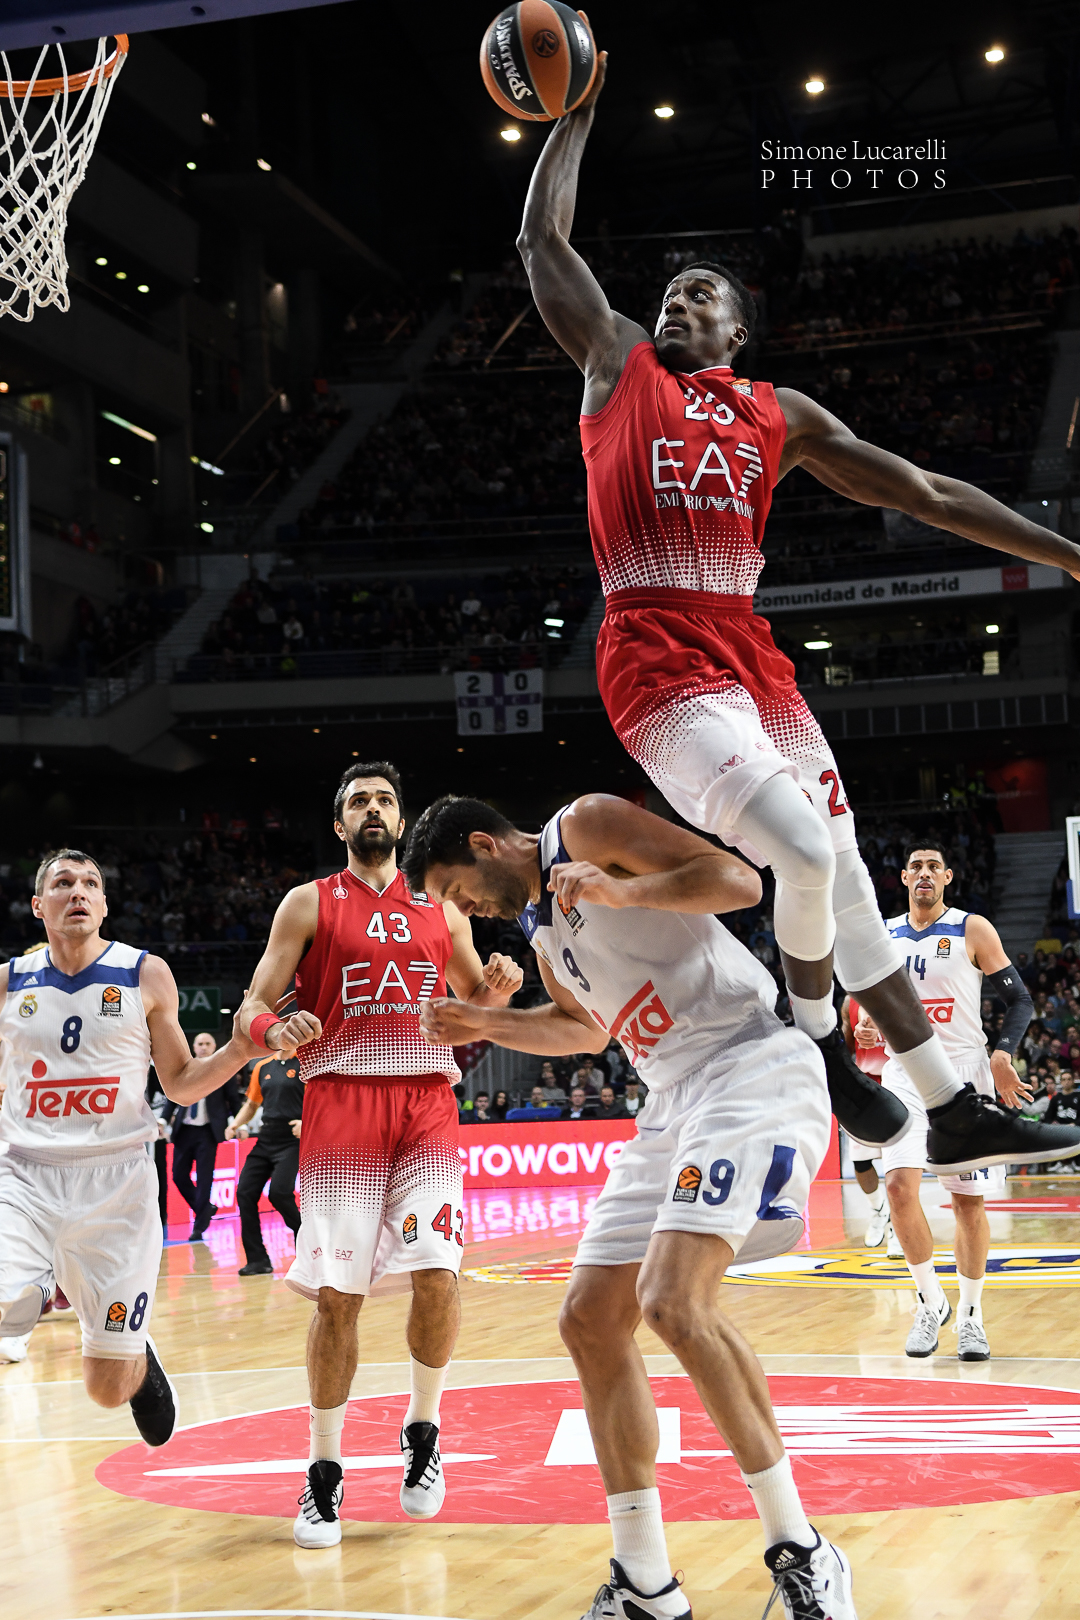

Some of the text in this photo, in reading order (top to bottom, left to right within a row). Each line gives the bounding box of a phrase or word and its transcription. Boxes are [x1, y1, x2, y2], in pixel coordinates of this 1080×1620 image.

[684, 387, 736, 426] 23
[652, 437, 763, 499] EA7
[752, 577, 960, 608] Comunidad de Madrid
[467, 675, 480, 693] 2
[516, 708, 529, 727] 9
[819, 769, 852, 817] 2
[366, 911, 412, 944] 43
[341, 960, 439, 1005] EA7
[562, 947, 591, 993] 9
[905, 954, 926, 980] 14
[1003, 977, 1013, 986] 14
[343, 1003, 392, 1019] EMPORIO
[60, 1015, 83, 1054] 8
[702, 1158, 736, 1206] 9
[129, 1291, 148, 1331] 8
